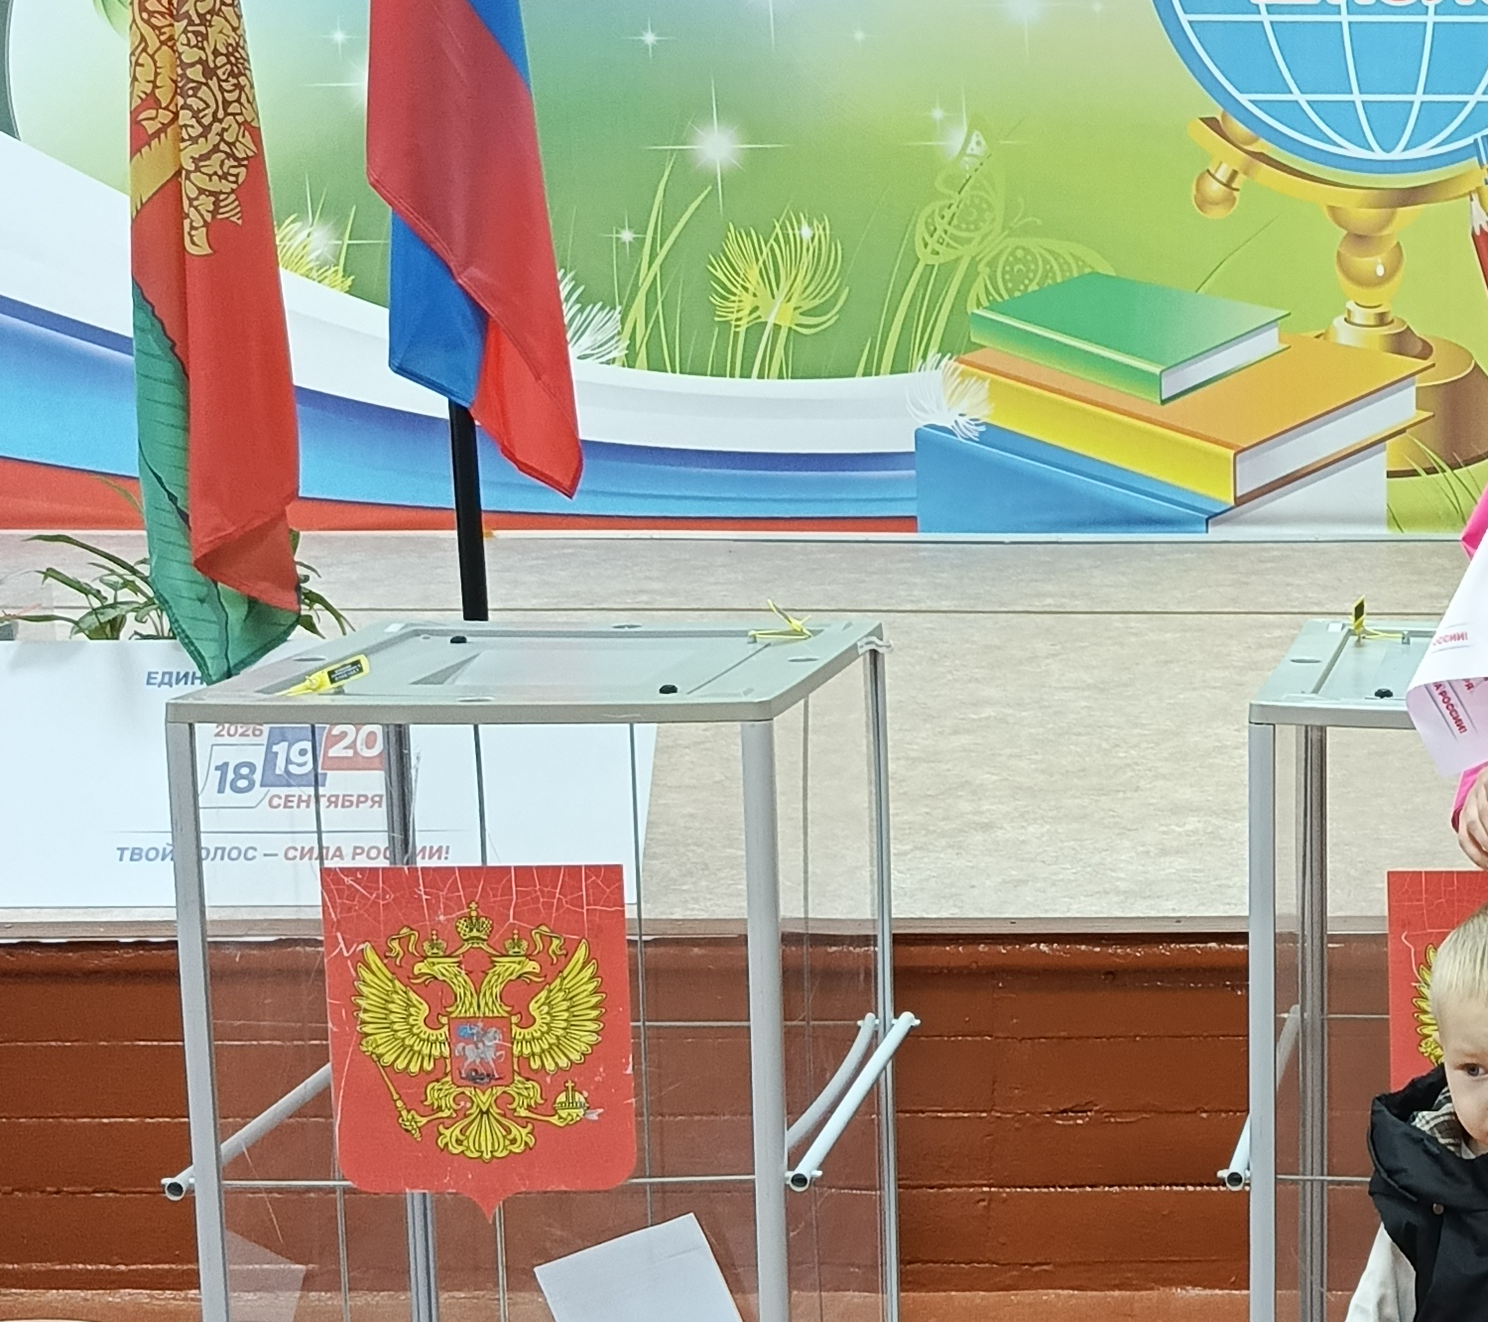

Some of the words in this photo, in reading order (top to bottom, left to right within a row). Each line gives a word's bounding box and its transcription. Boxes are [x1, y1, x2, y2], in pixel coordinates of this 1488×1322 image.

[145, 671, 205, 687] ЕДИН
[213, 724, 264, 738] 2026
[213, 761, 257, 794] 18
[270, 740, 318, 775] 19
[328, 724, 384, 758] 20
[267, 794, 384, 809] СЕНТЯБРЯ
[200, 846, 258, 861] ОЛОС
[283, 845, 344, 861] СИЛА
[350, 845, 451, 861] РОСИИ!
